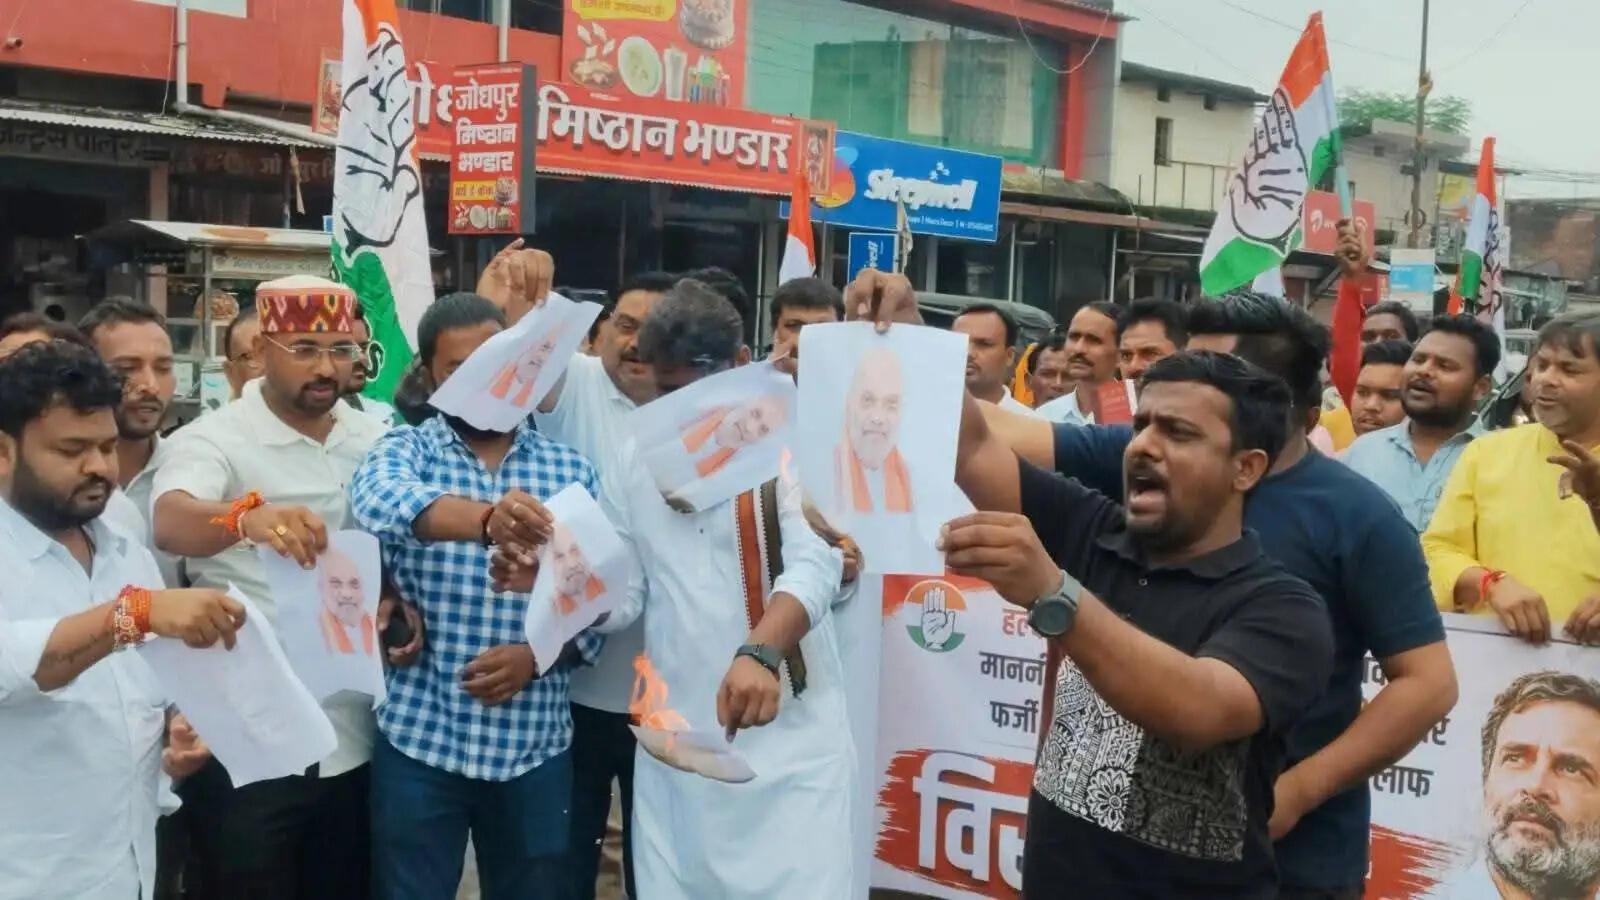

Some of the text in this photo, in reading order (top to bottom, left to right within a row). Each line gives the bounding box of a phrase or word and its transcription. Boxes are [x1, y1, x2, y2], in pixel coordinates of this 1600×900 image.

[454, 77, 519, 121] जोधपुर
[456, 117, 517, 145] मिष्ठान
[537, 84, 792, 170] मिष्ठान भण्डार
[457, 151, 515, 172] भण्डार
[990, 699, 1039, 734] फर्जी
[1372, 765, 1435, 798] लाफ
